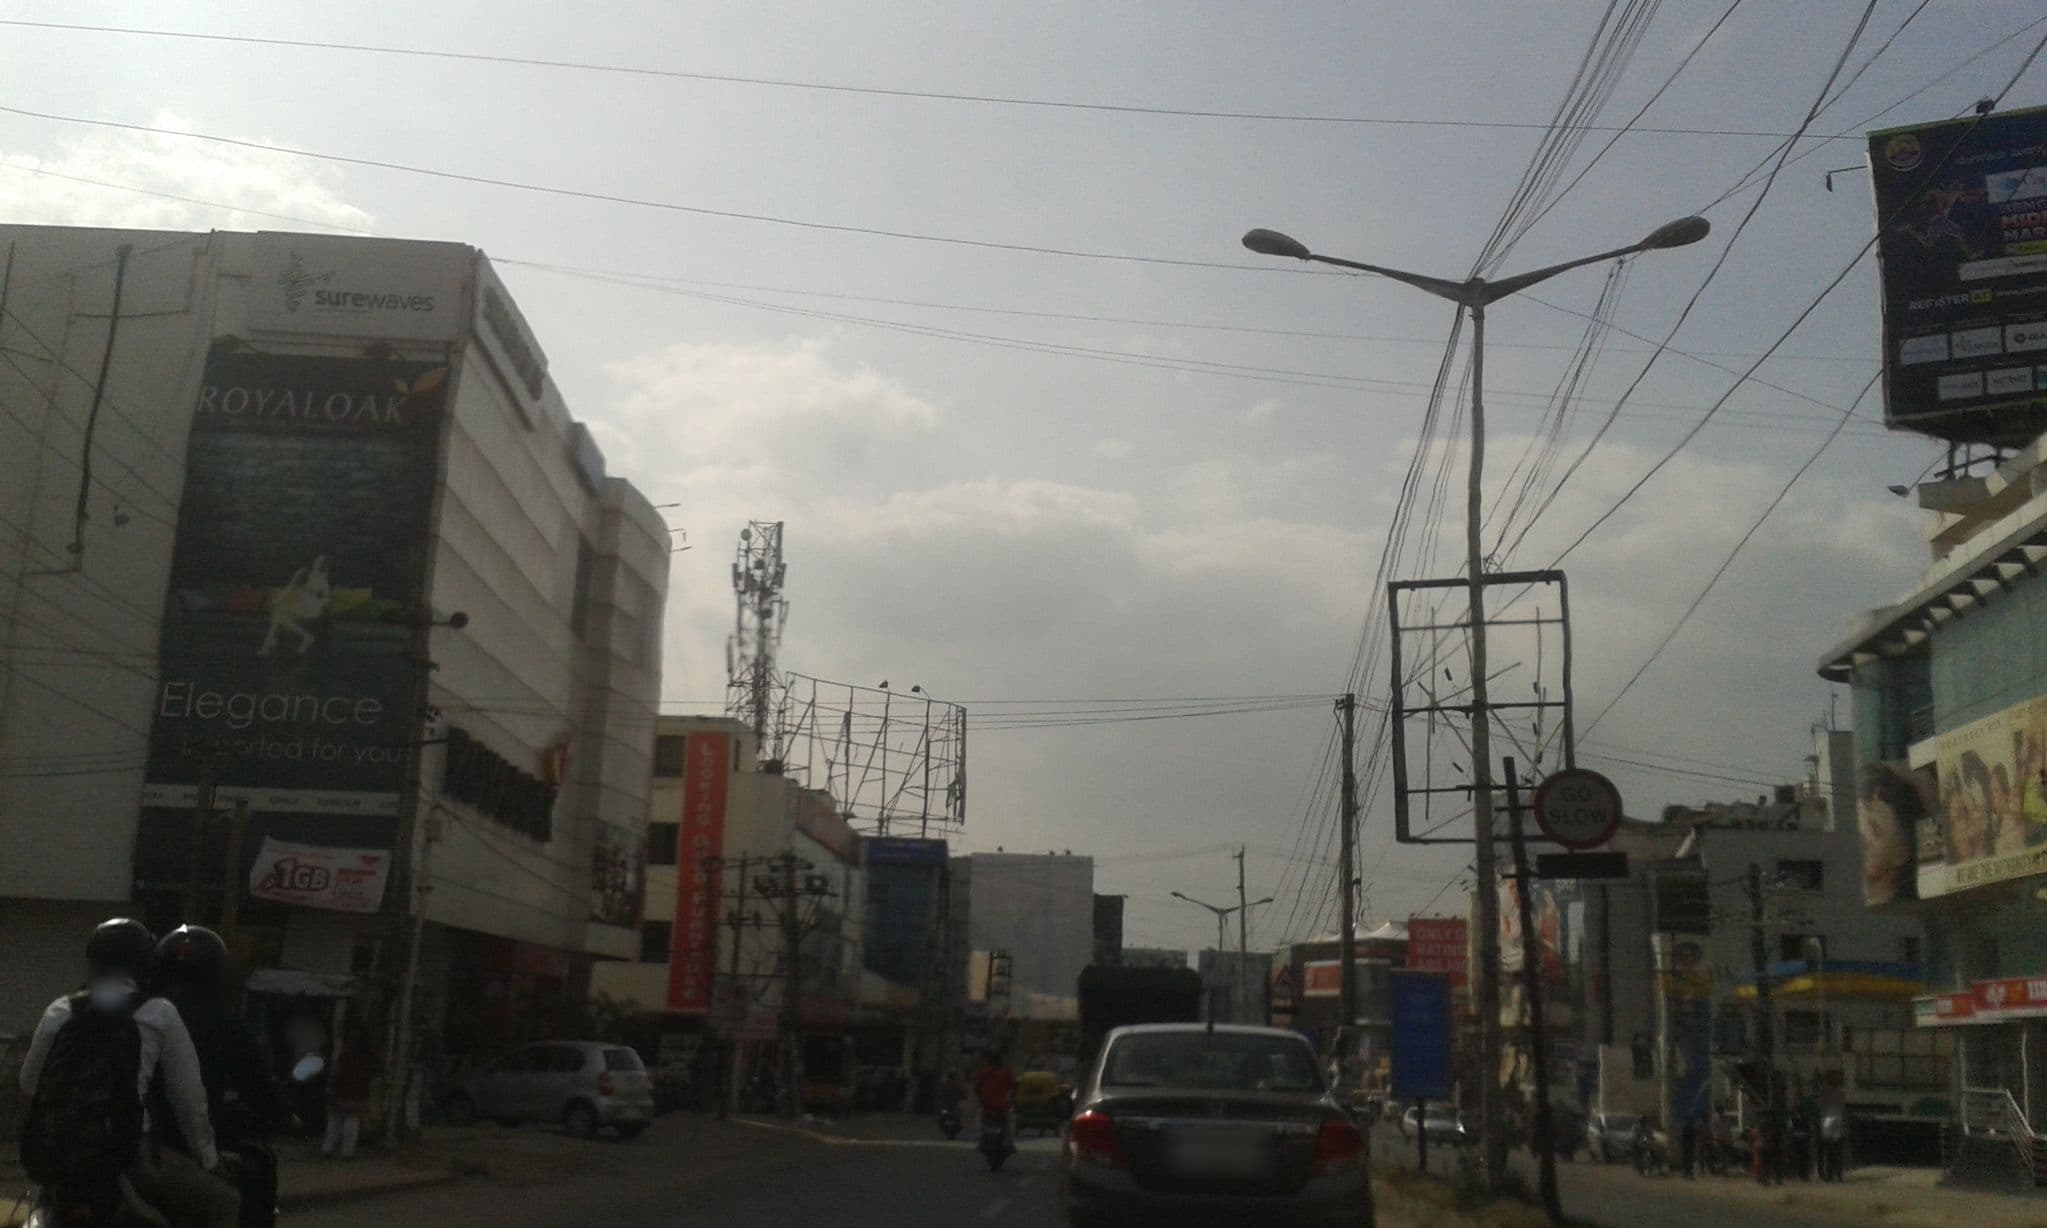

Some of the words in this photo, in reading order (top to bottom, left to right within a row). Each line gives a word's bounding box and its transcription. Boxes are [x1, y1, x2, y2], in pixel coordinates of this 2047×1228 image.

[315, 288, 434, 313] surewaves
[196, 384, 409, 424] ROYALOAK
[160, 682, 382, 729] Elegance
[311, 736, 344, 761] for
[354, 744, 402, 764] you
[1560, 786, 1593, 801] GO
[1548, 807, 1608, 825] SLOW
